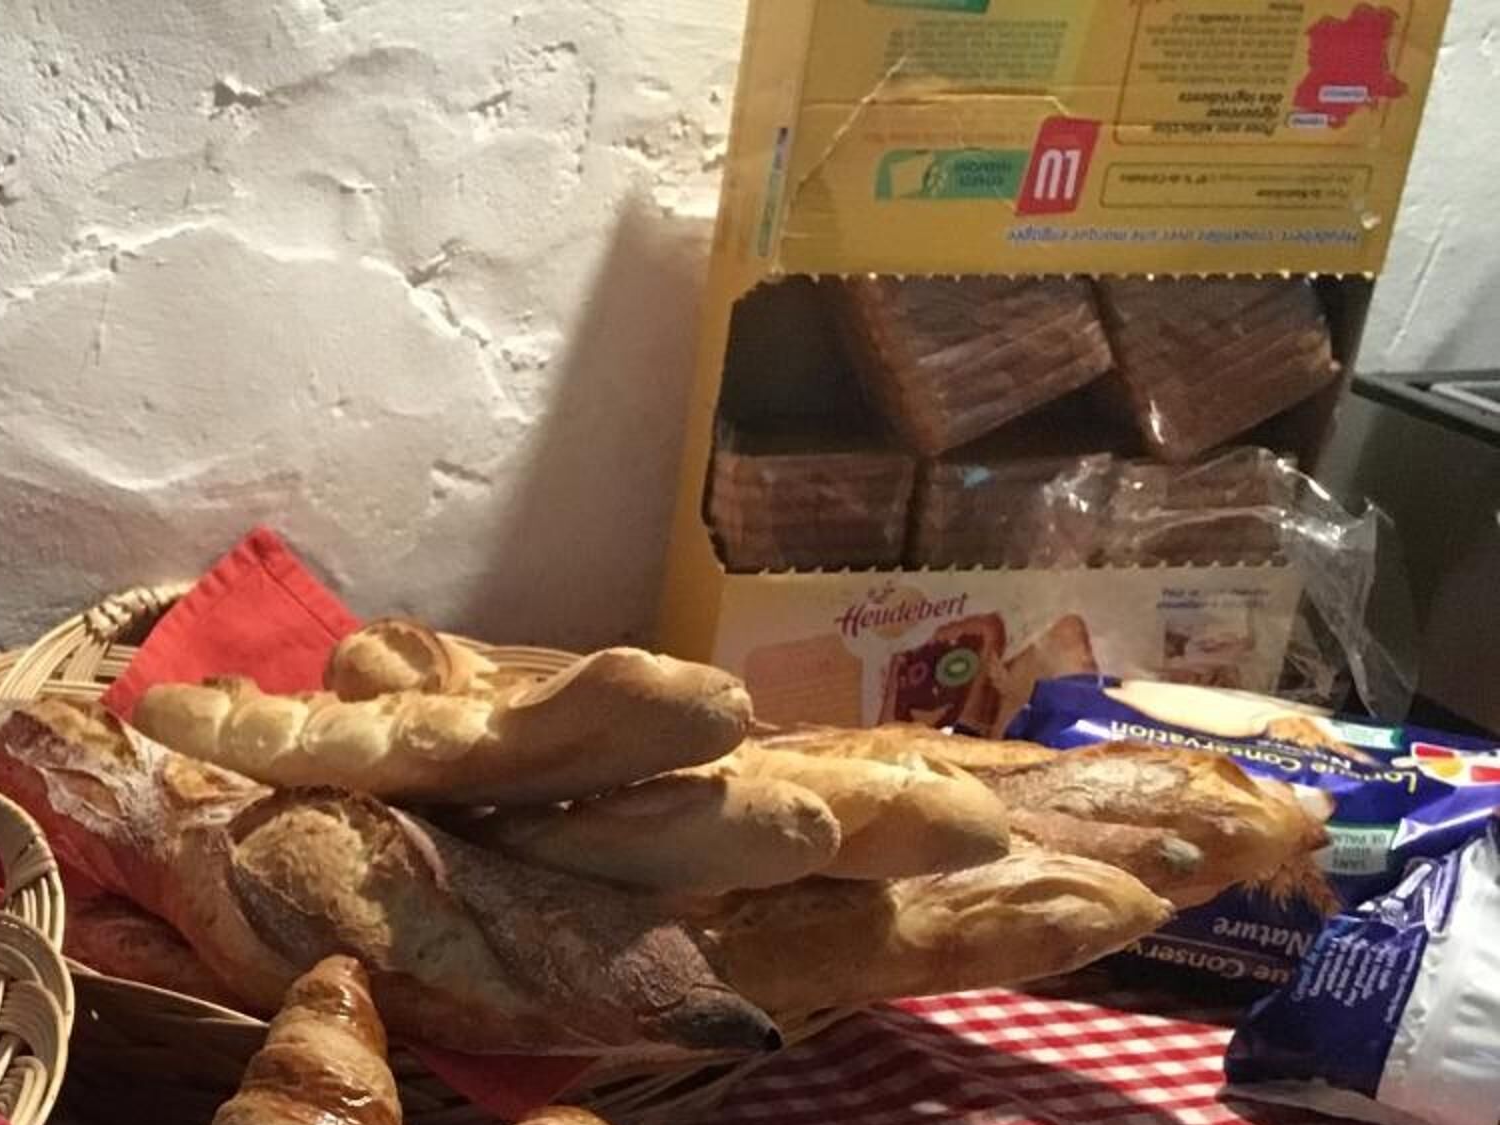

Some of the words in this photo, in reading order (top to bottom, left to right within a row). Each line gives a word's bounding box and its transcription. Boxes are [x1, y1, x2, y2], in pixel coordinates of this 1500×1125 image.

[1033, 148, 1082, 200] LU
[834, 592, 968, 638] Heudebert
[1110, 720, 1302, 773] Conservation
[1211, 917, 1314, 957] Nature
[1123, 941, 1246, 980] Conserv
